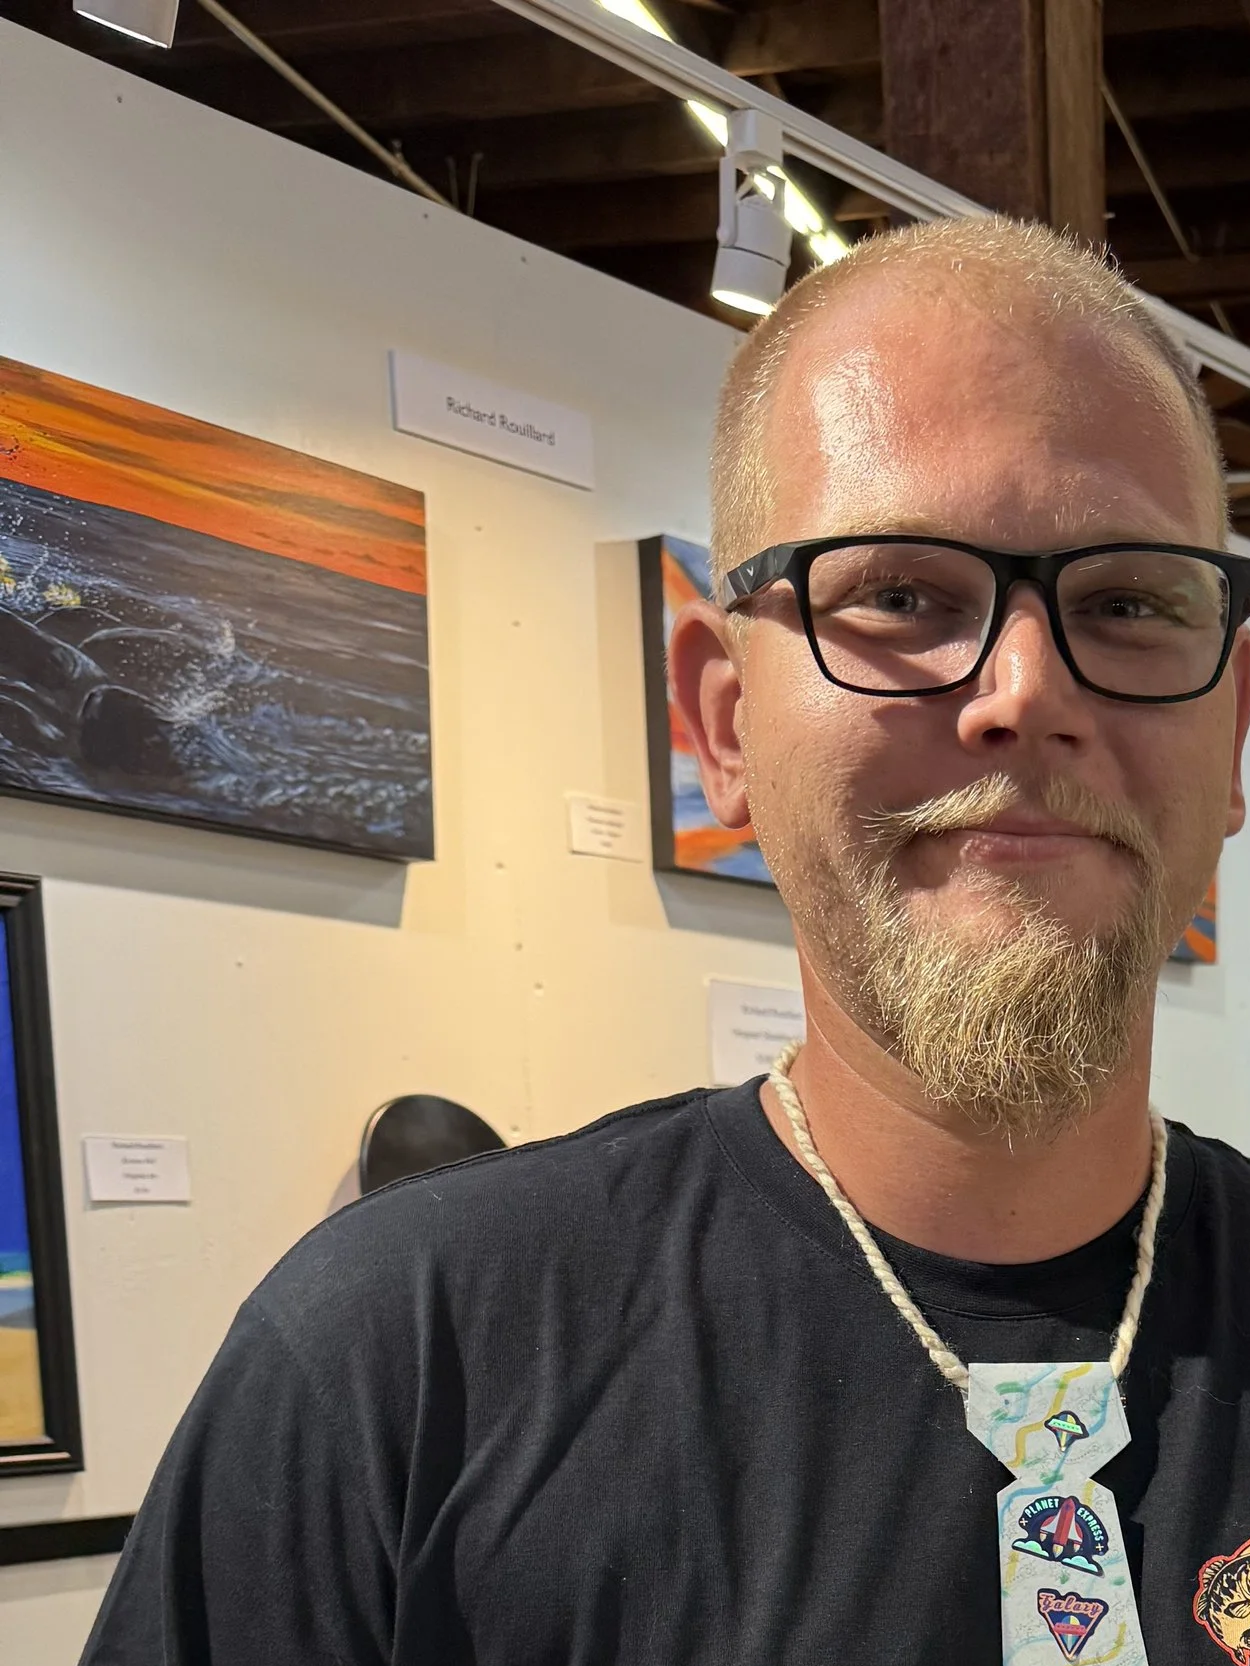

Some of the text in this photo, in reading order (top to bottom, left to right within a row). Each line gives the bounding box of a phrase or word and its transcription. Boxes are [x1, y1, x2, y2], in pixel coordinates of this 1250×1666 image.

[446, 396, 556, 446] Richard Rouillard
[1025, 1498, 1104, 1543] PLANET EXPRESS
[1040, 1594, 1103, 1618] Galaxy
